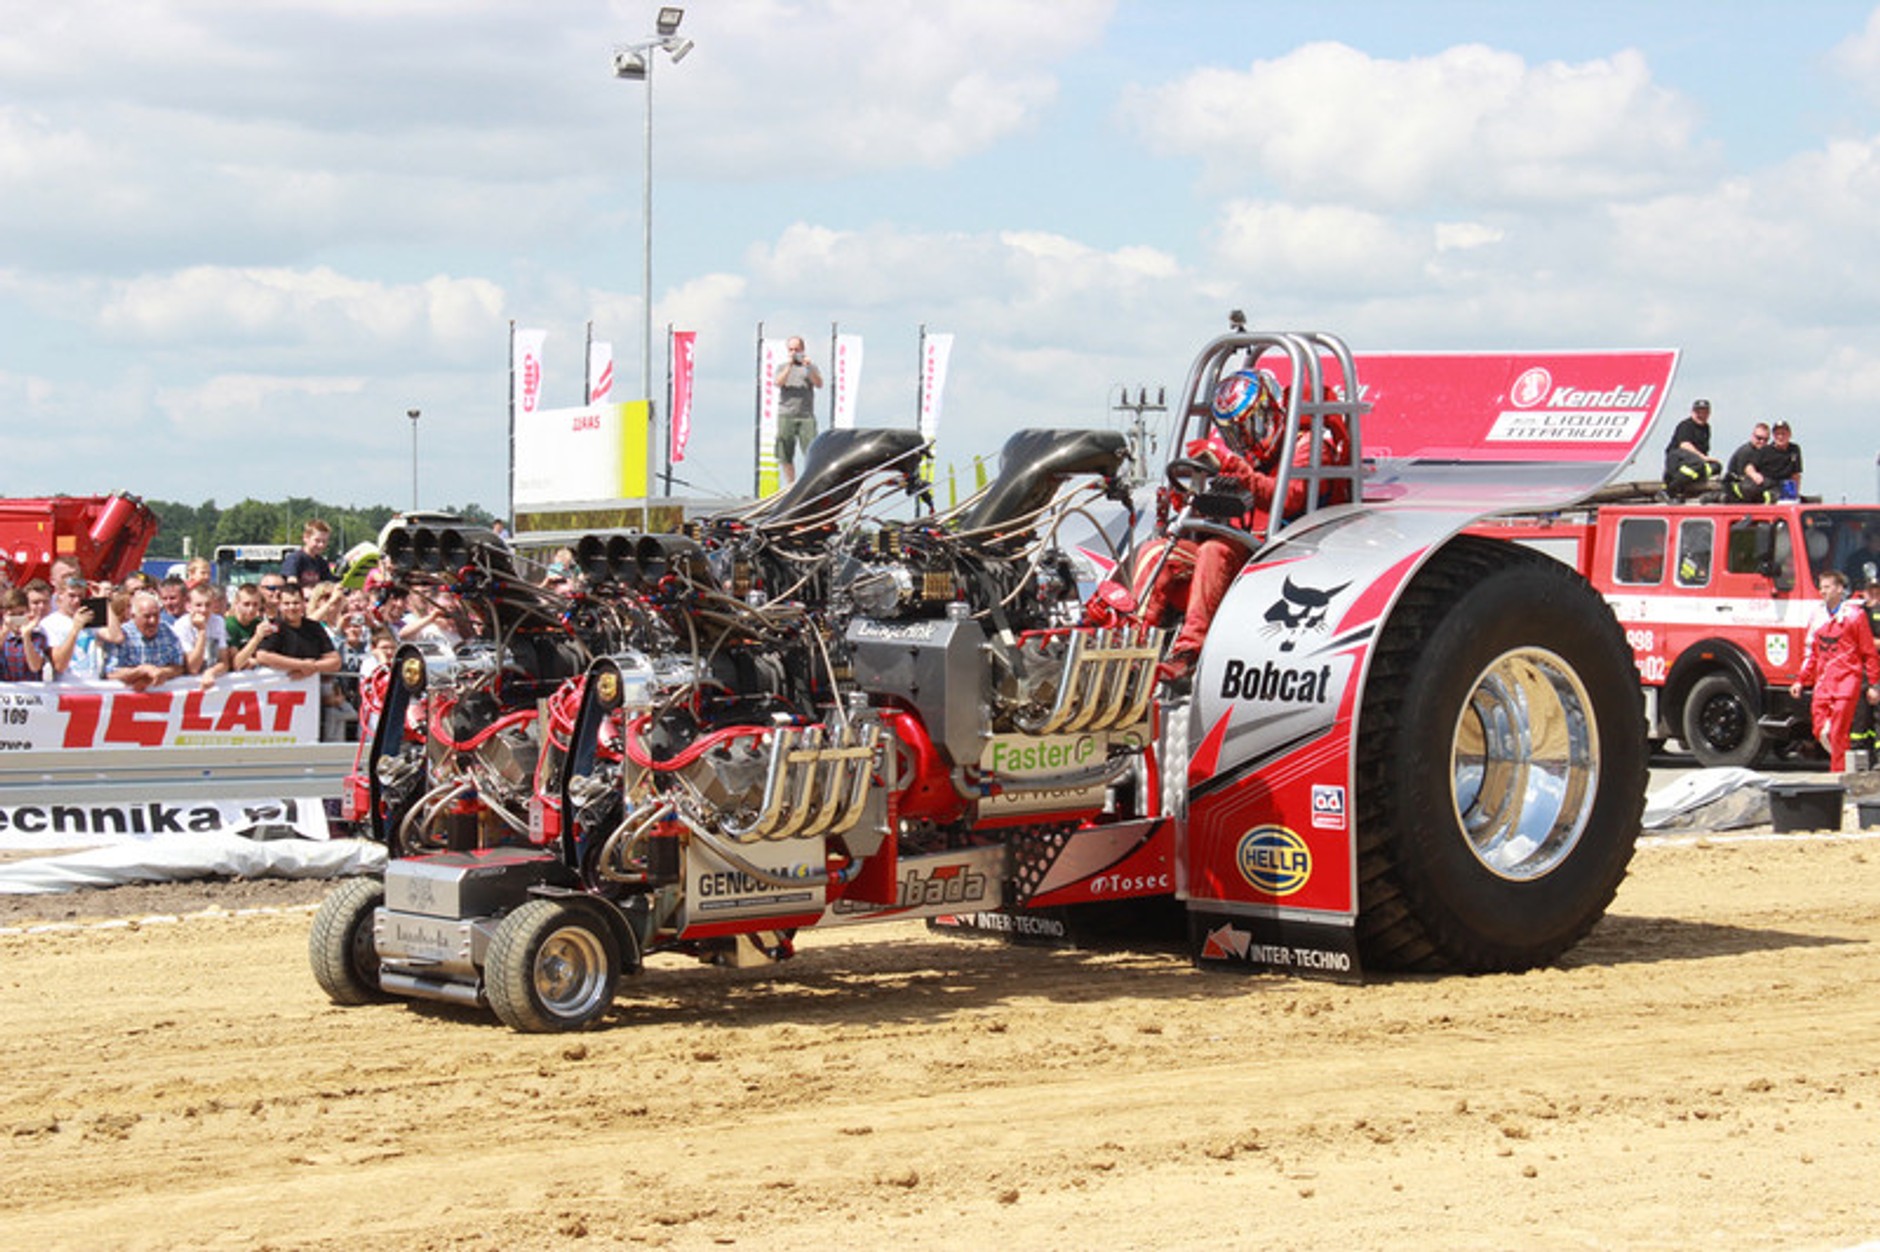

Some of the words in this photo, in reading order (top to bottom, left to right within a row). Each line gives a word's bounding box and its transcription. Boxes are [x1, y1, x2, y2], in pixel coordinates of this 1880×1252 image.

[1547, 385, 1655, 408] Kendall
[1507, 427, 1623, 438] TITANIUM
[1544, 415, 1630, 426] LIQUID
[1221, 659, 1331, 703] Bobcat
[181, 691, 306, 731] LAT
[993, 741, 1072, 771] Faster
[1246, 849, 1308, 873] HELLA
[1110, 874, 1168, 892] Tosec
[1250, 944, 1351, 972] INTER-TECHNO
